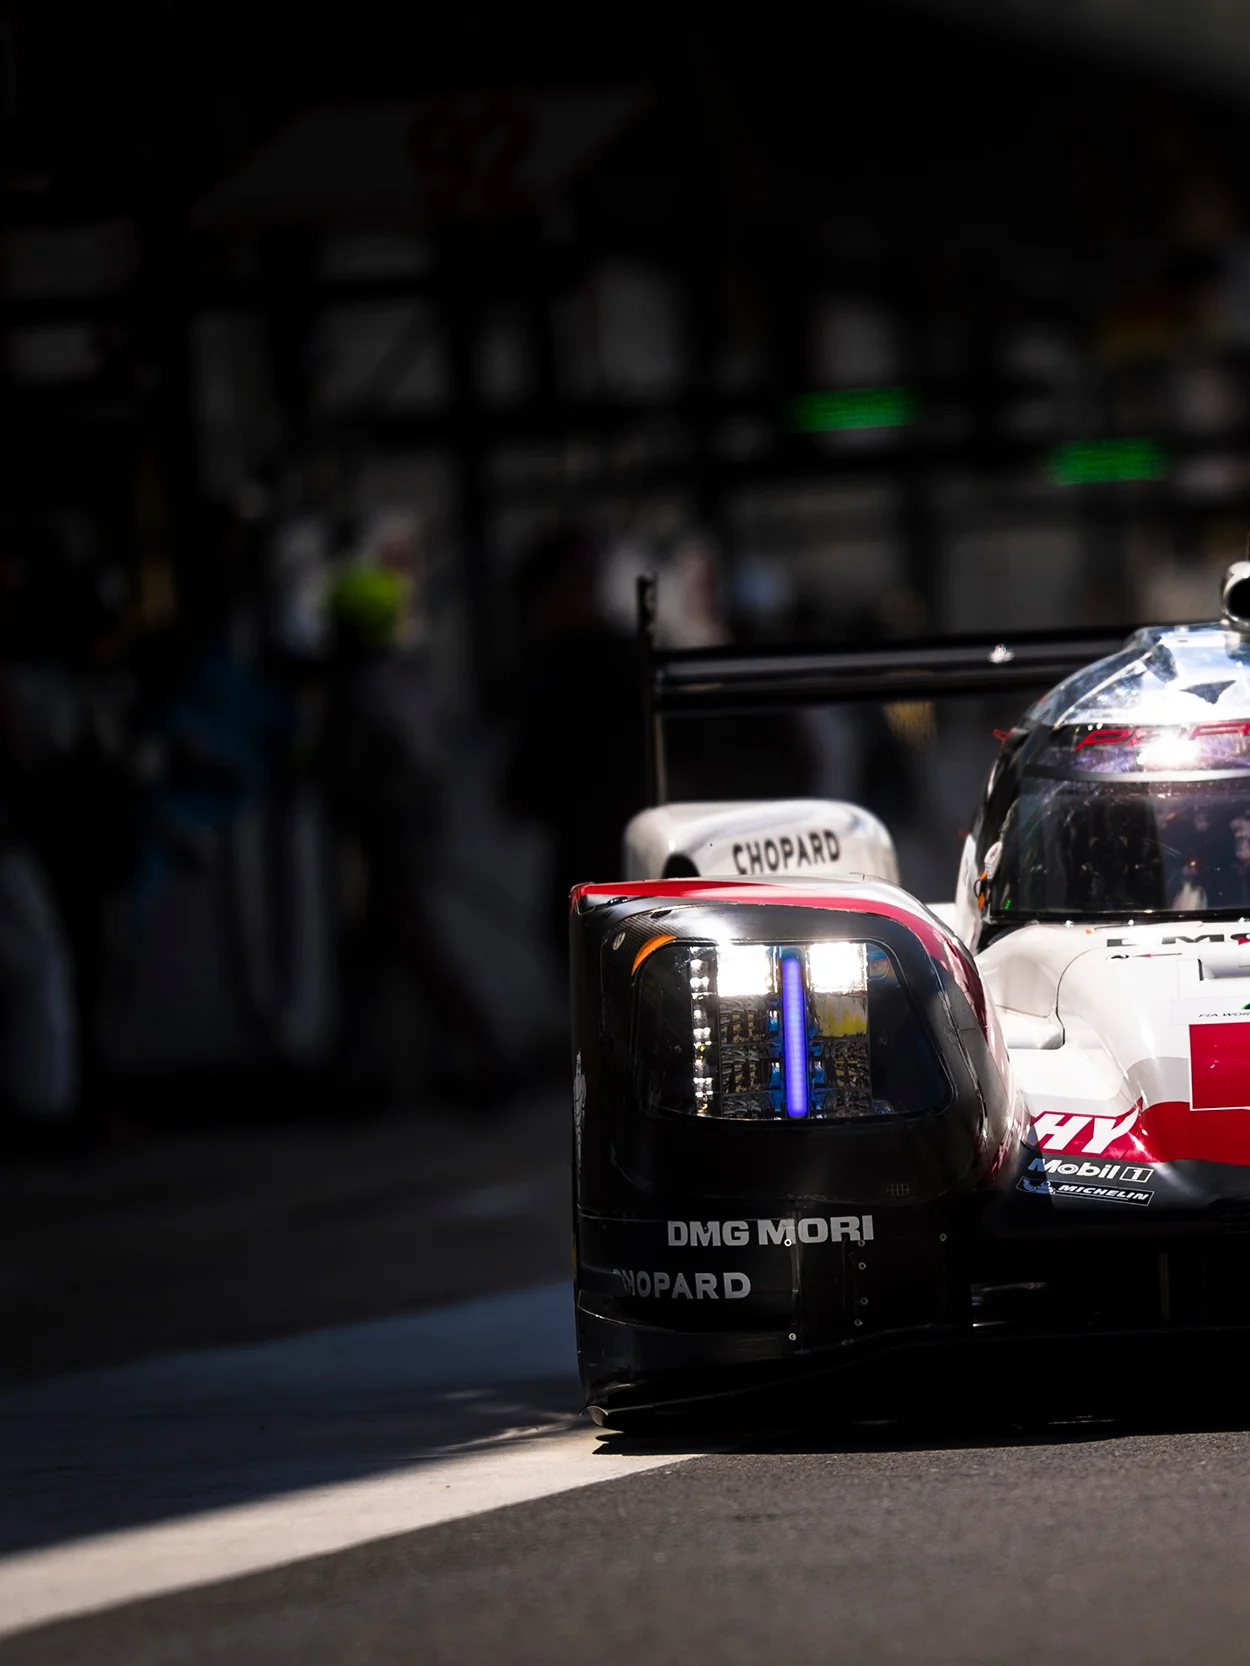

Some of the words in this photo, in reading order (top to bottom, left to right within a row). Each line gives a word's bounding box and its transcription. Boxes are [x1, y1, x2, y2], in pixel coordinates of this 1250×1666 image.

[732, 829, 841, 875] CHOPARD
[1033, 1106, 1139, 1154] HY
[1027, 1158, 1122, 1180] Mobil
[1059, 1184, 1150, 1201] MICHELIN
[667, 1220, 749, 1247] DMG
[757, 1215, 875, 1246] MORI
